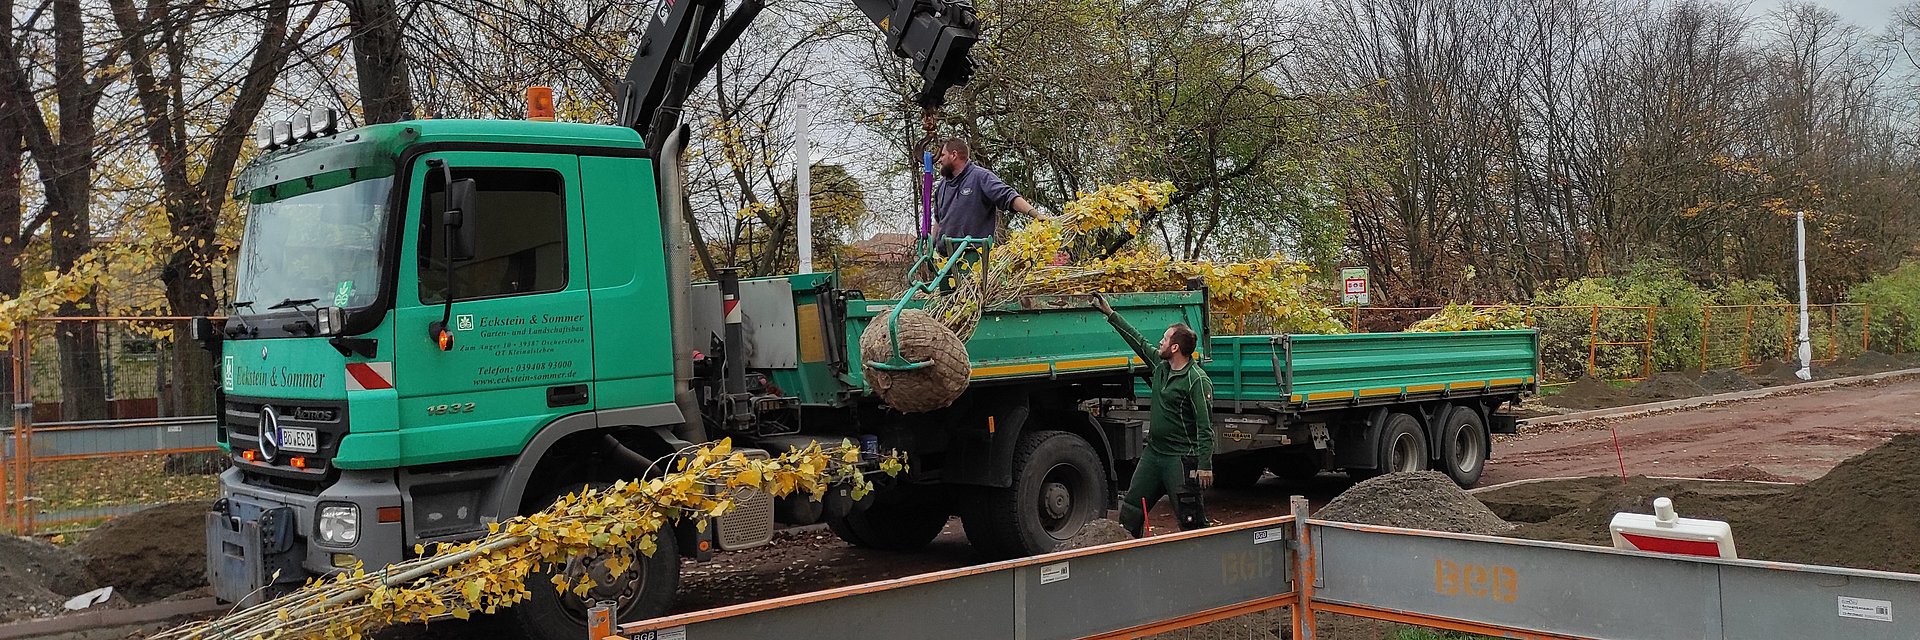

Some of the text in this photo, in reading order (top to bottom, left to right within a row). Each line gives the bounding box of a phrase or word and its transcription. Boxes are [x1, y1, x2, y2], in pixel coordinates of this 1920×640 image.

[480, 314, 584, 327] Eckstein & Sommer
[480, 325, 584, 338] Garten- und Landschaftsbau
[479, 343, 500, 351] Anger
[541, 338, 585, 346] Oschersleben
[478, 361, 572, 375] Telefon: 039408 93000
[236, 366, 325, 388] Eckstein & Sommer
[473, 370, 577, 386] www.eckstein-sommer.de
[427, 402, 476, 416] 1832
[283, 430, 315, 447] BÖ ES 81
